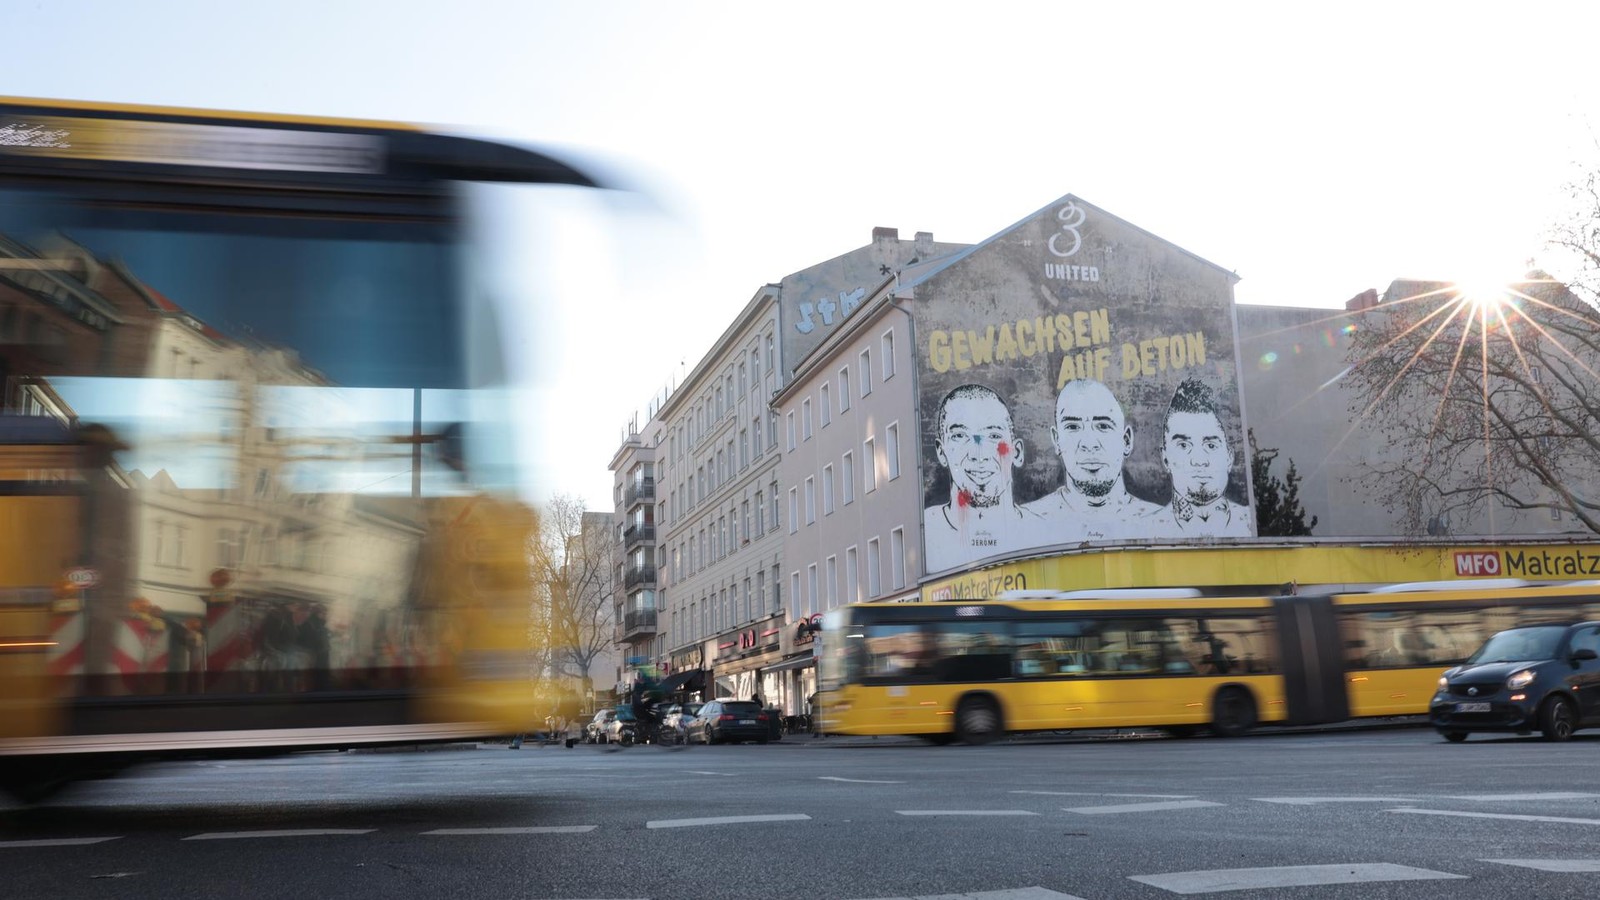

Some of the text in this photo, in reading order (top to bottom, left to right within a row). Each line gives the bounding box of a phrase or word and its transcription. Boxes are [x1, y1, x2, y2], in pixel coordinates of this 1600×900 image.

[1048, 201, 1086, 257] 3
[1045, 263, 1099, 282] UNITED
[929, 309, 1110, 373] GEWACHSEN
[1057, 331, 1206, 389] AUF BETON
[1456, 553, 1499, 575] MFO
[953, 573, 1027, 600] Matratzen
